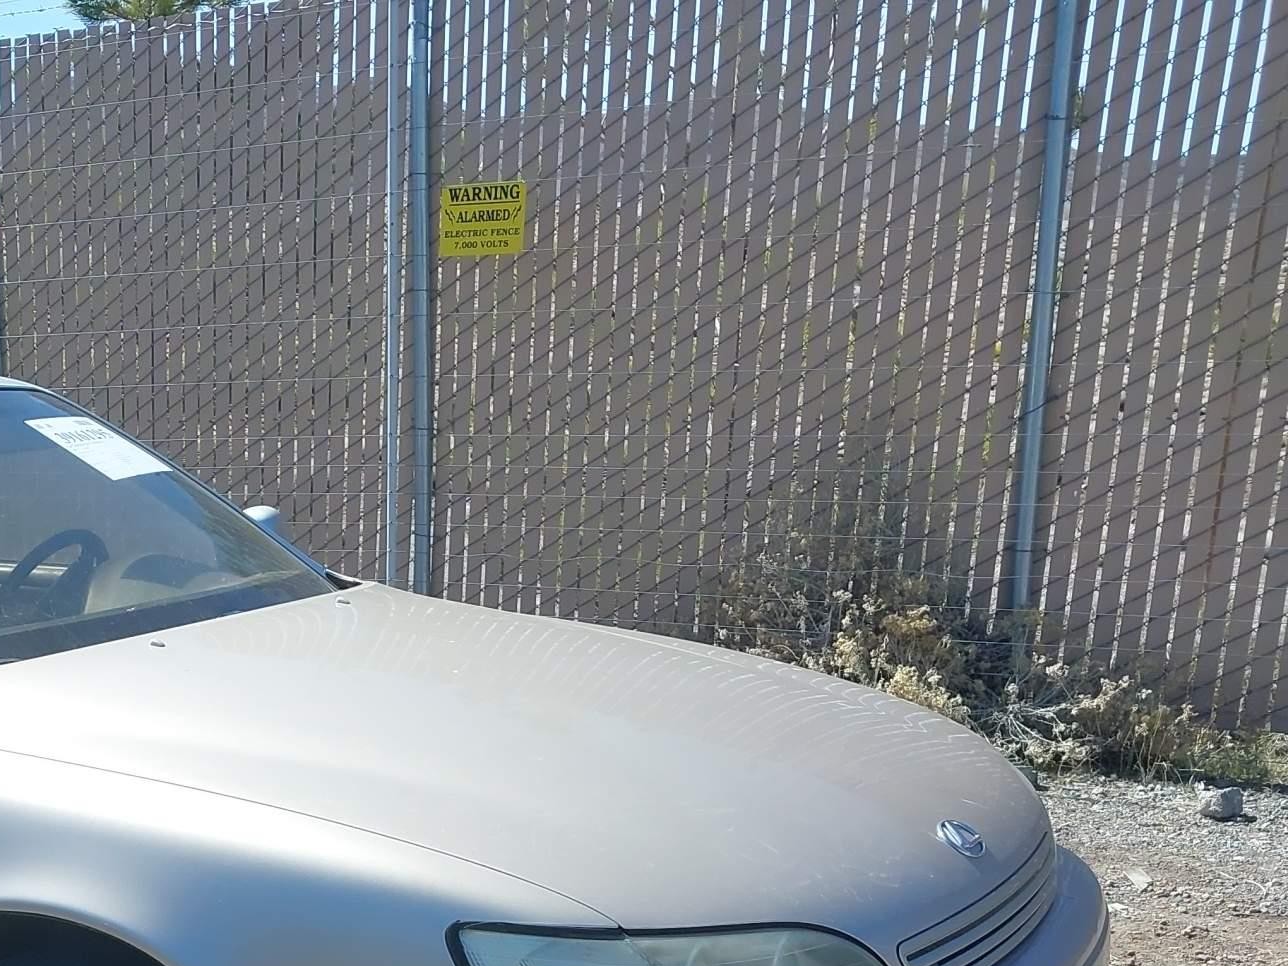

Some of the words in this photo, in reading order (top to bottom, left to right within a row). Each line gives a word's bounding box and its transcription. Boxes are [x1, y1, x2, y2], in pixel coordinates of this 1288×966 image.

[448, 184, 520, 202] WARNING
[456, 208, 510, 223] ALARMED
[444, 229, 488, 238] ELECTRIC
[490, 227, 520, 236] FENCE
[480, 239, 509, 248] VOLTS
